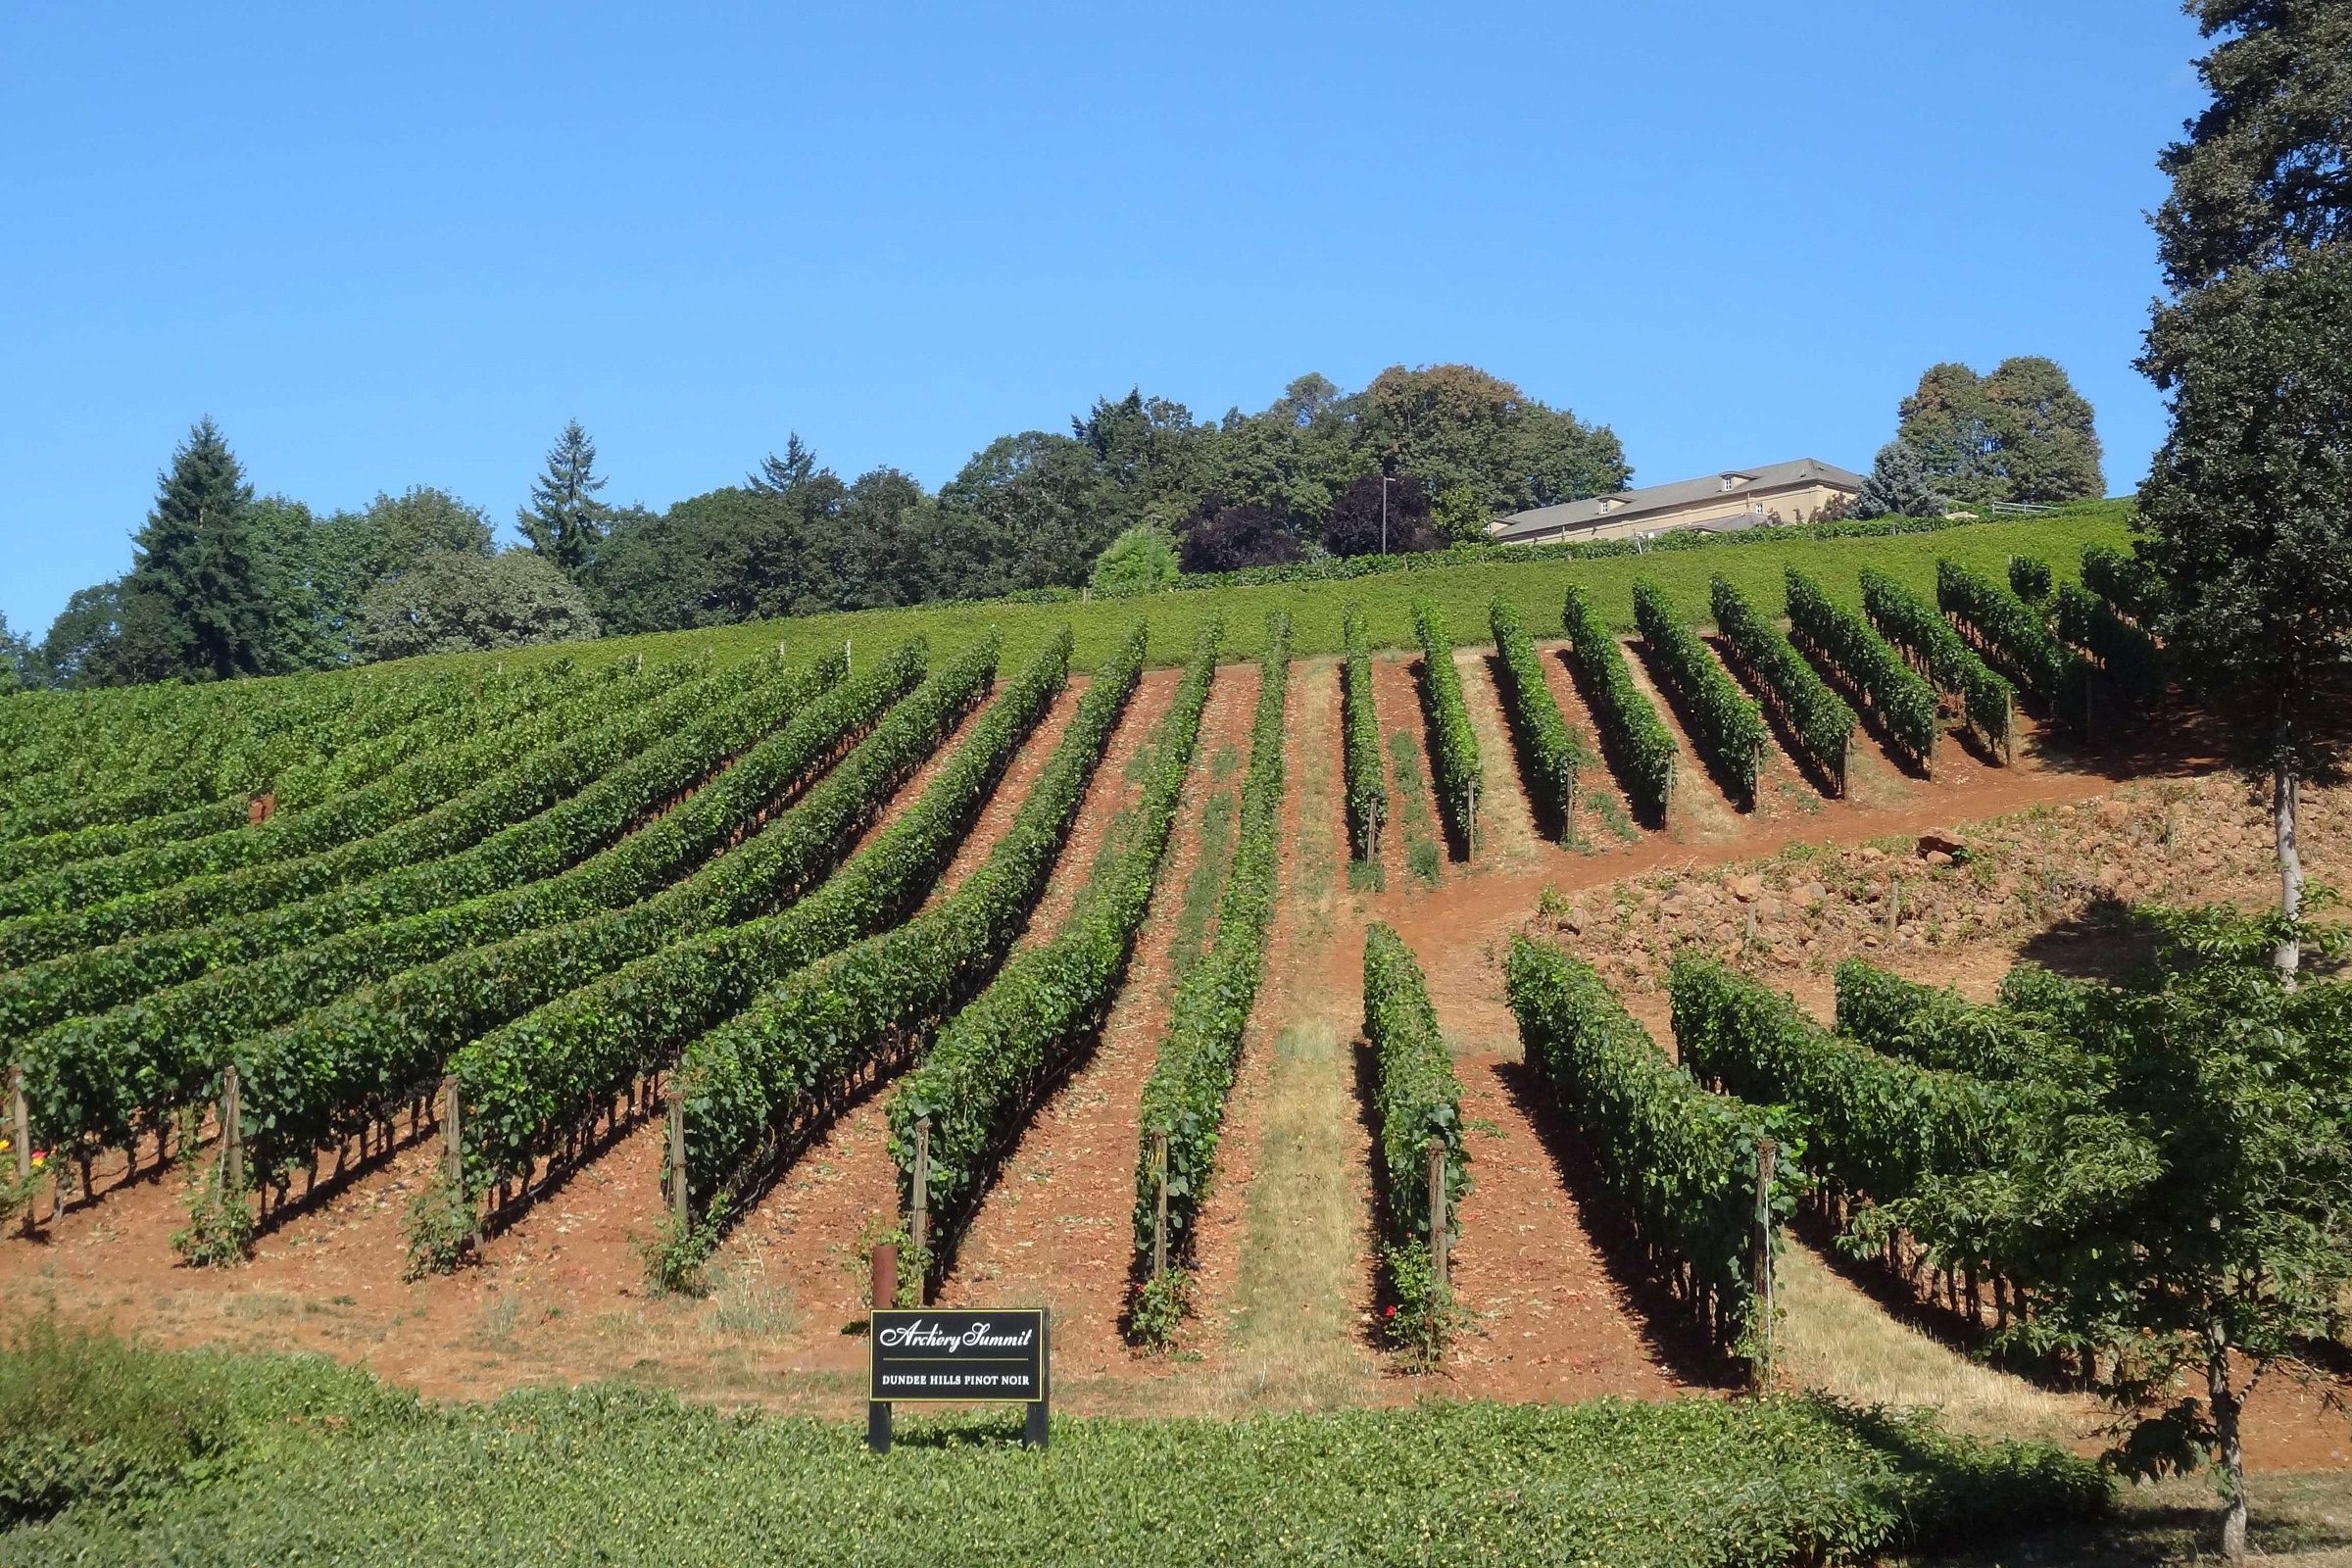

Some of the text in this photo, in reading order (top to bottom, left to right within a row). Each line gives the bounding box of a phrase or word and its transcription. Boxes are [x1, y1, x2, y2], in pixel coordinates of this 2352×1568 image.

[879, 1319, 1033, 1353] Archery Summit
[882, 1375, 1030, 1386] DUNDEE HILLS PINOT NOIR
